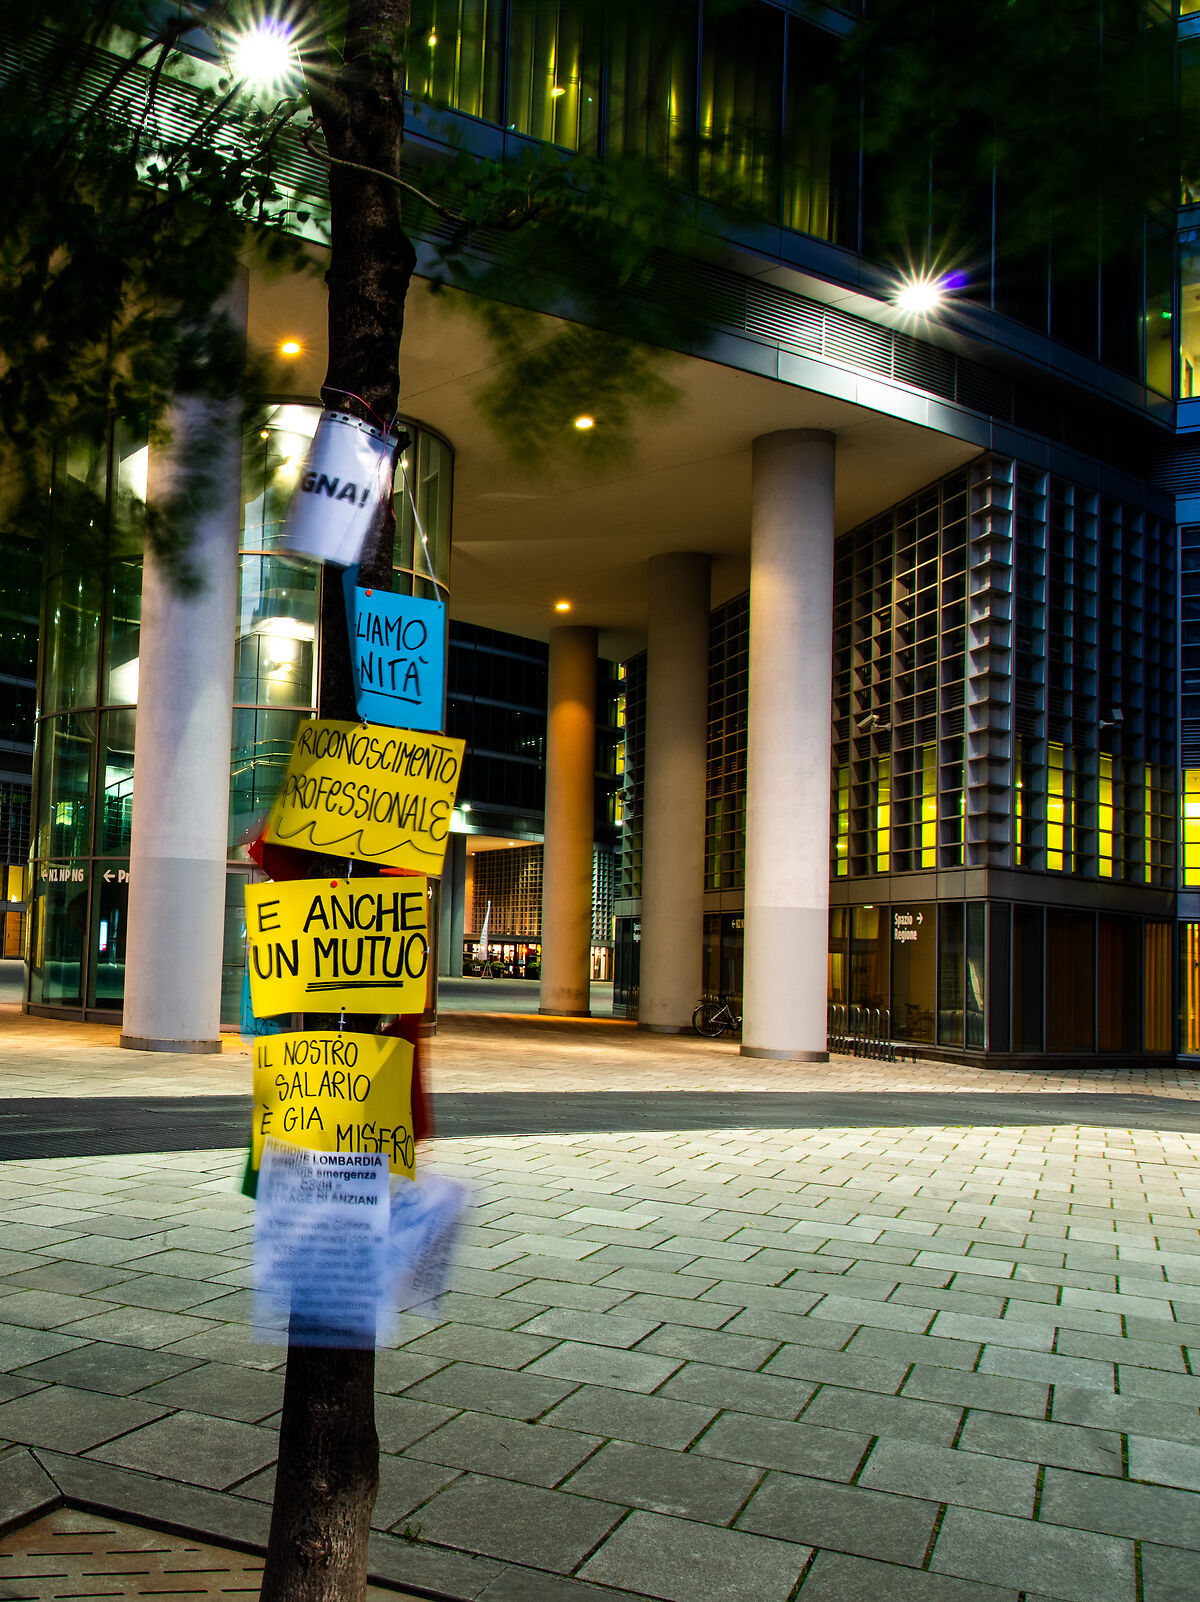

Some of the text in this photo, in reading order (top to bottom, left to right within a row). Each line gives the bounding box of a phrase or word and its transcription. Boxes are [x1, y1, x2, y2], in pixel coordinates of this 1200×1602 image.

[59, 868, 71, 882] NP
[257, 891, 427, 933] E ANCHE
[894, 912, 913, 928] Spazio
[894, 928, 918, 943] Regione
[253, 938, 299, 980] UN
[313, 932, 429, 979] MUTUO
[258, 1039, 359, 1069] IL NOSTRO
[275, 1070, 371, 1102] SALARIO
[283, 1106, 324, 1132] GIA
[336, 1121, 415, 1169] MISERO
[313, 1153, 383, 1167] LOMBARDIA
[330, 1194, 378, 1206] ANZIANI
